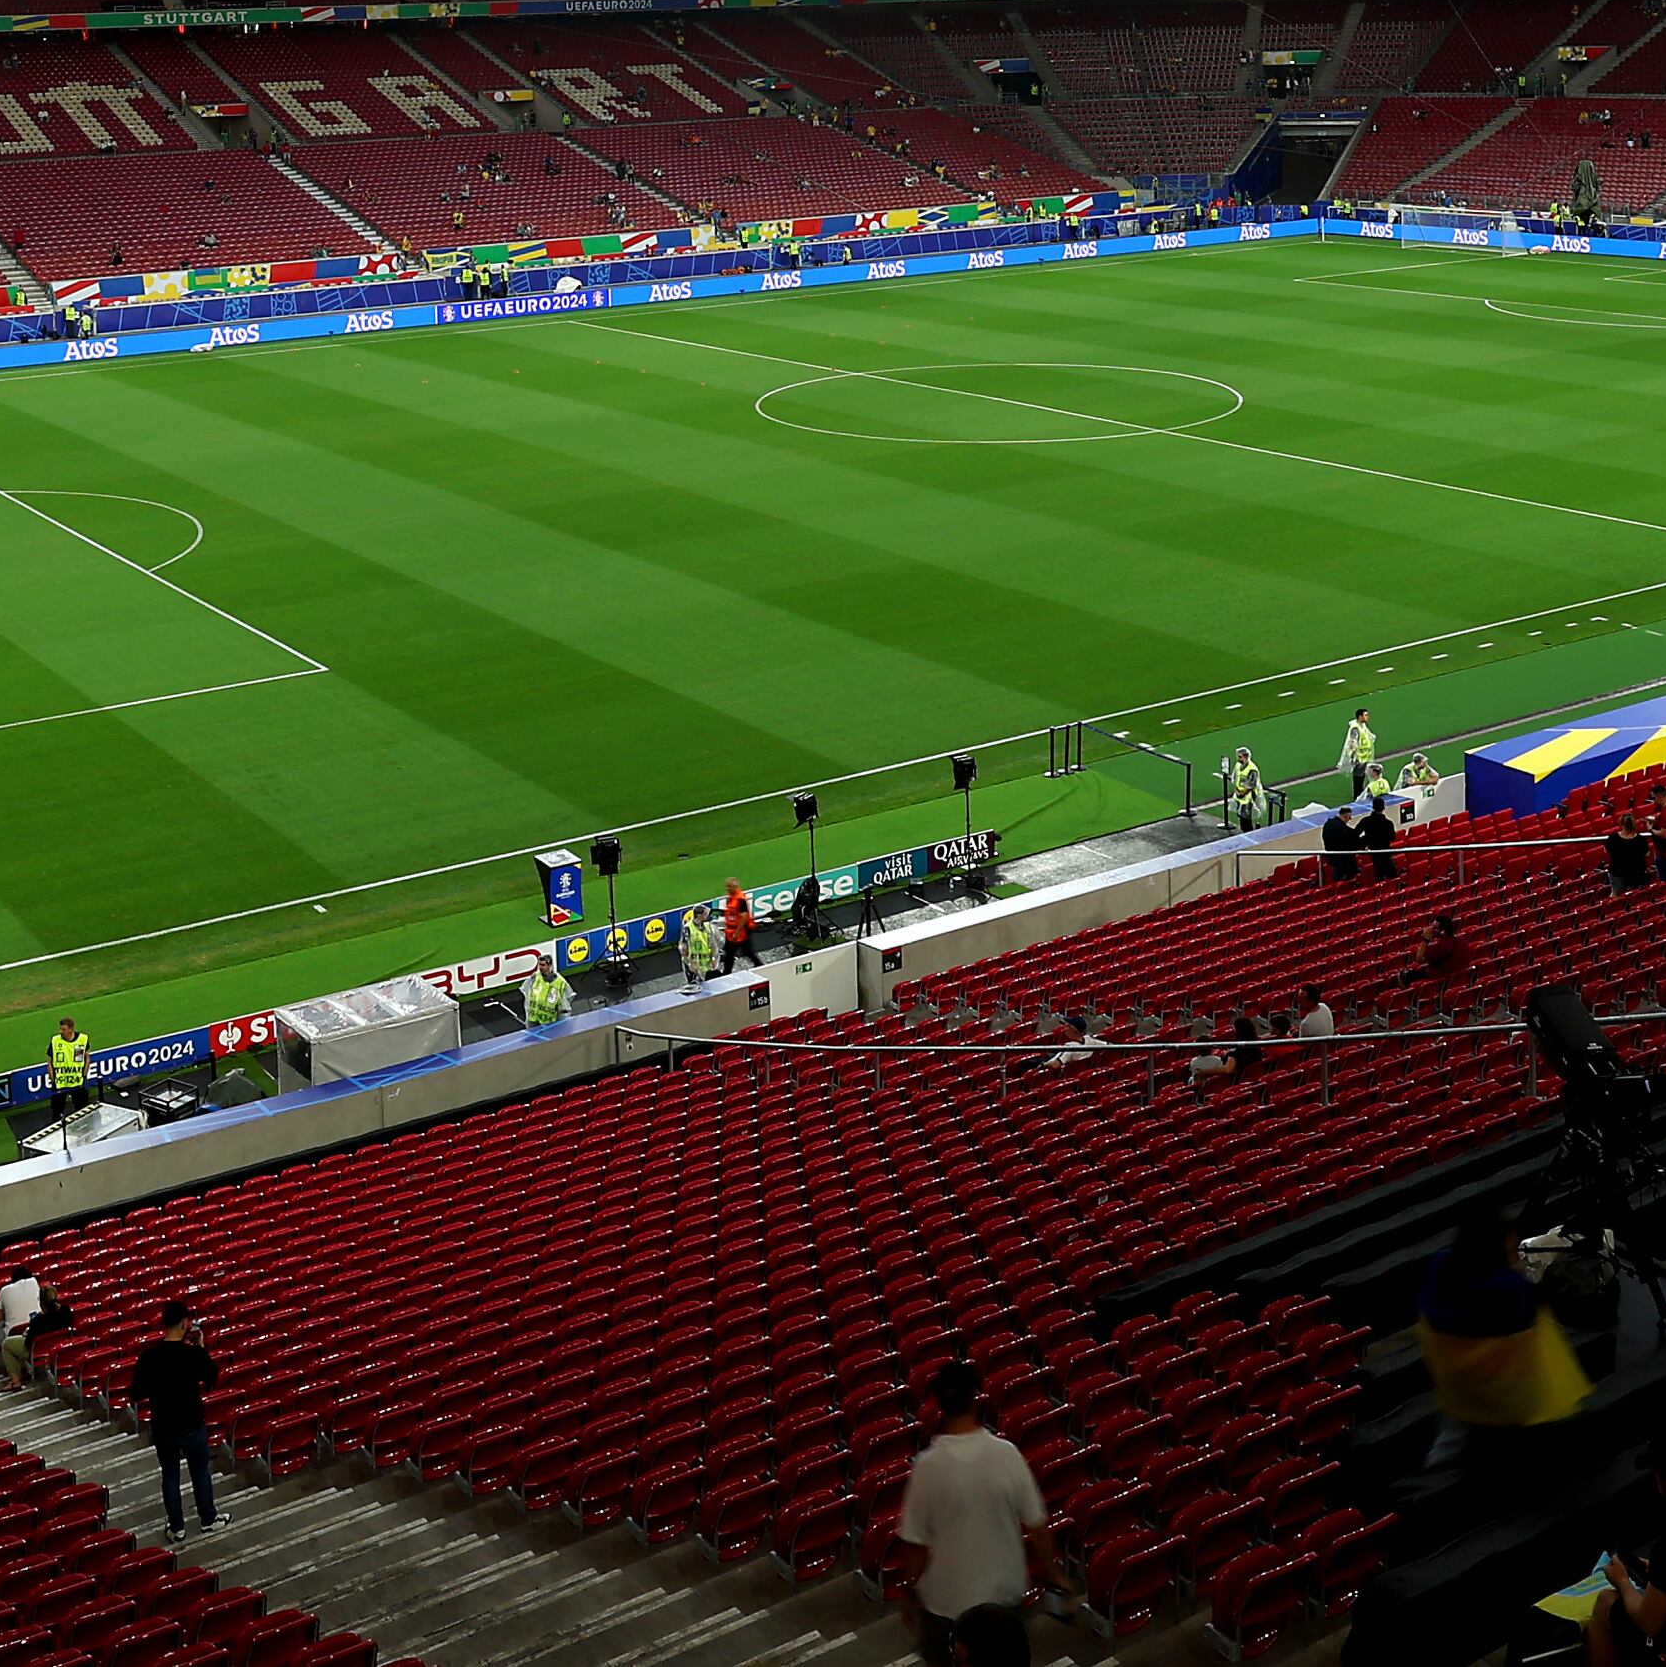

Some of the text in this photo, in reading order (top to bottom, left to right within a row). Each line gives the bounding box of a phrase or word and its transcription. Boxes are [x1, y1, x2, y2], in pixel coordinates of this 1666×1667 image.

[143, 11, 248, 25] STUTTGART
[934, 834, 989, 861] QATAR
[885, 853, 912, 869] visit
[873, 864, 913, 885] QATAR
[421, 949, 542, 995] BYD
